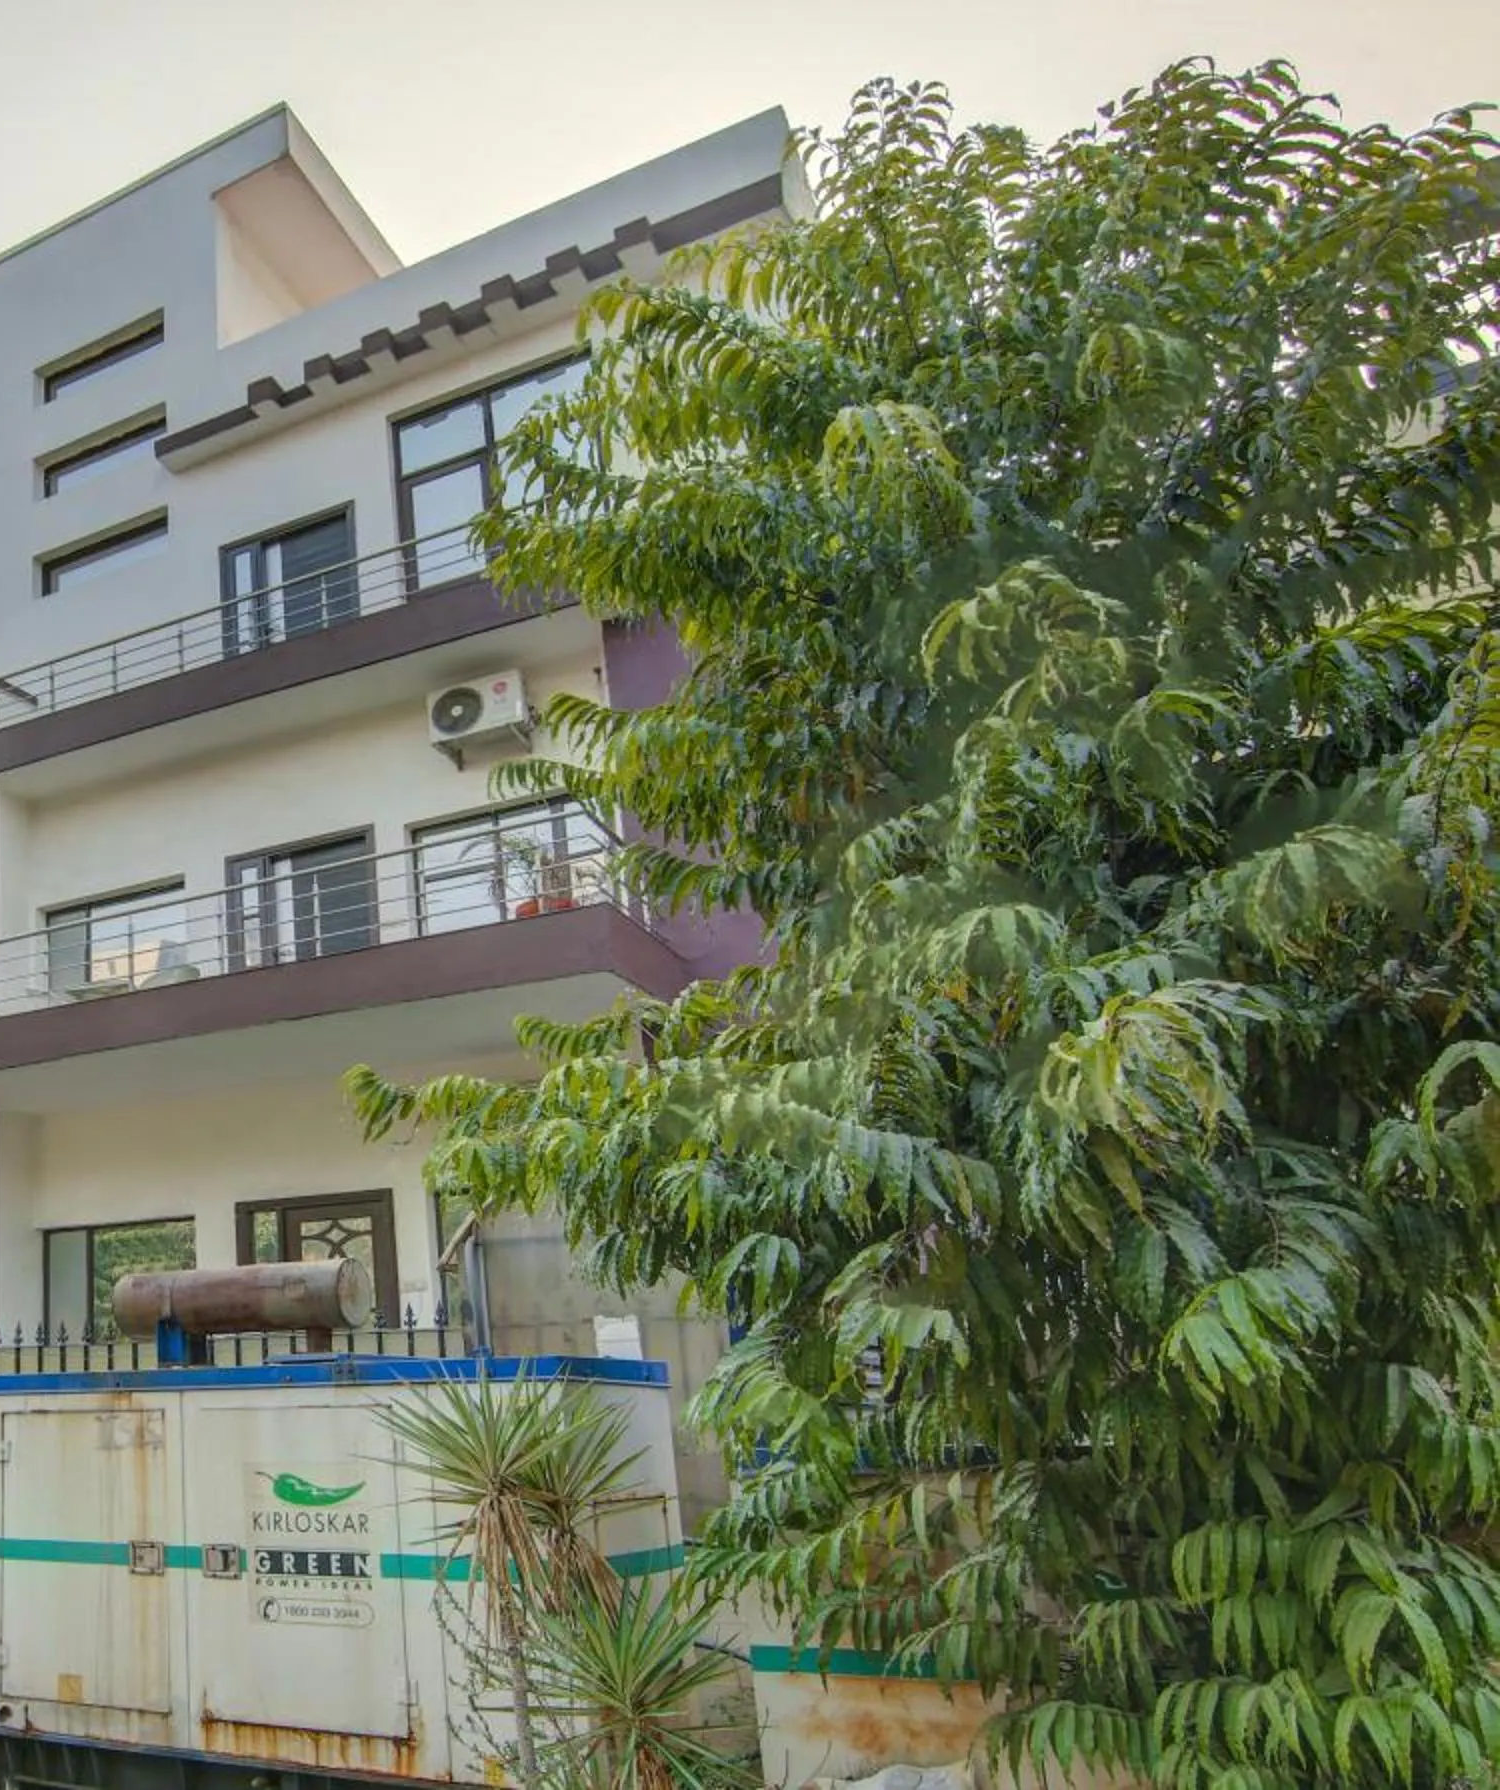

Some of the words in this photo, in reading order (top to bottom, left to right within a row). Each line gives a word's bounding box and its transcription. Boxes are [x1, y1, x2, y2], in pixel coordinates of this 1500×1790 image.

[252, 1511, 369, 1533] KIRLOSKAR
[256, 1551, 372, 1576] GREEN
[255, 1578, 310, 1588] POWER
